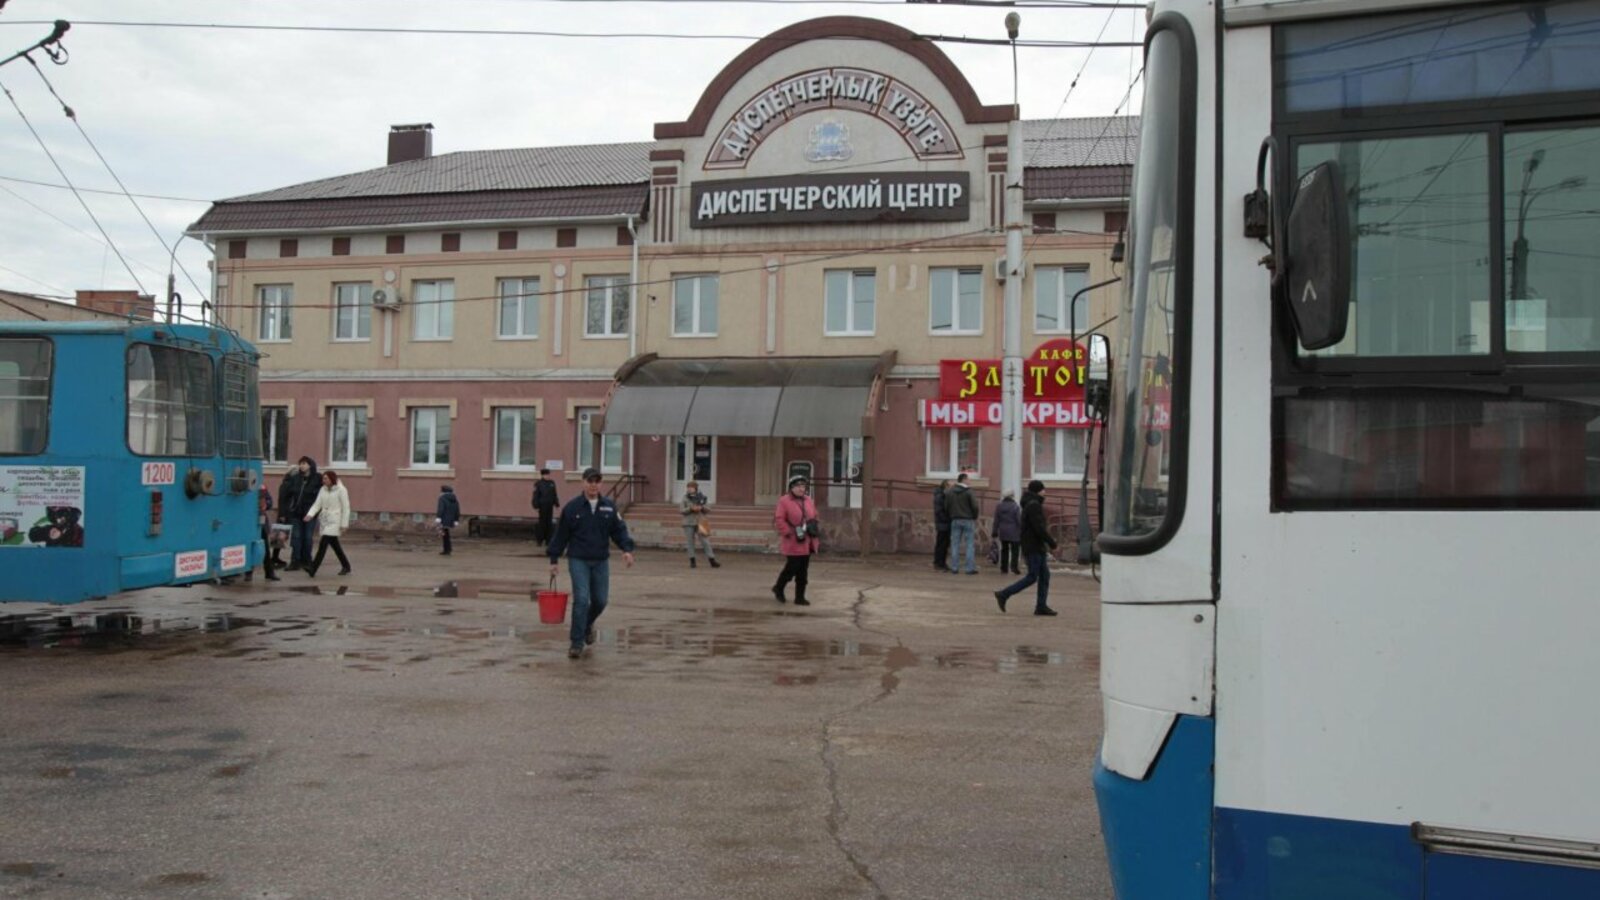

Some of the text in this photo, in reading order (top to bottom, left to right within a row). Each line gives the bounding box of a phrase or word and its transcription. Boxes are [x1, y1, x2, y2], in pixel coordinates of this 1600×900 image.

[698, 178, 963, 219] ДИСПЕТЧЕРСКИЙ ЦЕНТР
[1040, 349, 1083, 360] КАФЕ
[931, 403, 975, 424] МЫ
[145, 464, 173, 483] 1200
